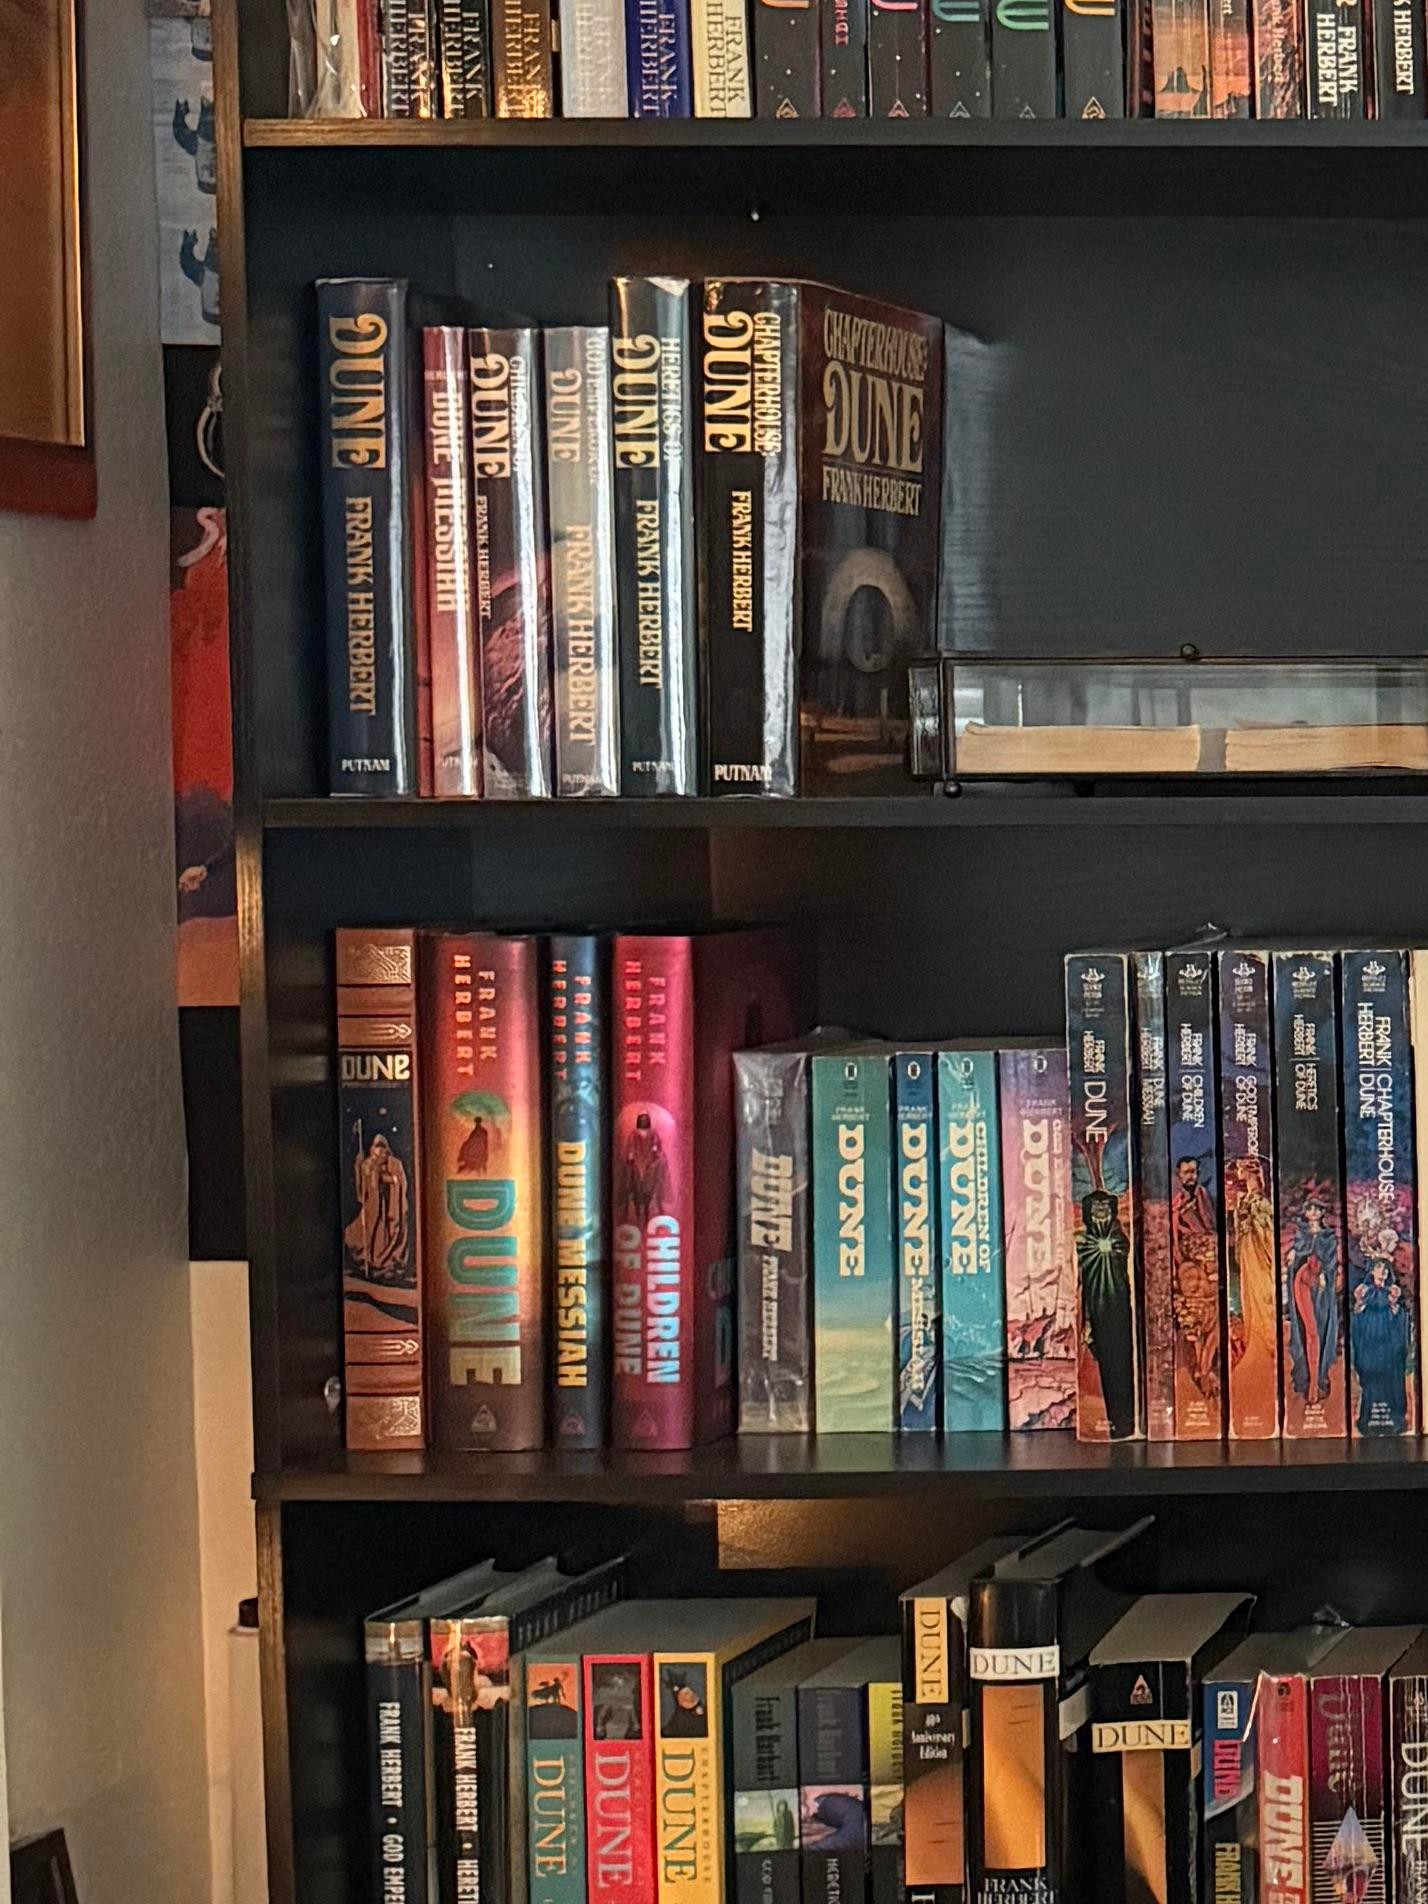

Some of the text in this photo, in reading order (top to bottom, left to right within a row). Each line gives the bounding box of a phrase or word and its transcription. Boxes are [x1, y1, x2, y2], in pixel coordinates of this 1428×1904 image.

[611, 333, 662, 469] DUNE
[703, 311, 753, 452] DUNE
[822, 360, 924, 472] DUNE
[328, 313, 388, 715] DUNE FRANK HERBERT
[445, 1178, 523, 1386] DUNE
[558, 1142, 588, 1387] DUNE MESSIAH
[646, 1215, 681, 1384] CHILDREN
[972, 1652, 1056, 1675] DUNE
[1097, 1724, 1189, 1748] DUNE
[532, 1756, 567, 1878] DUNE
[594, 1751, 633, 1889] DUNE
[661, 1748, 698, 1884] DUNE
